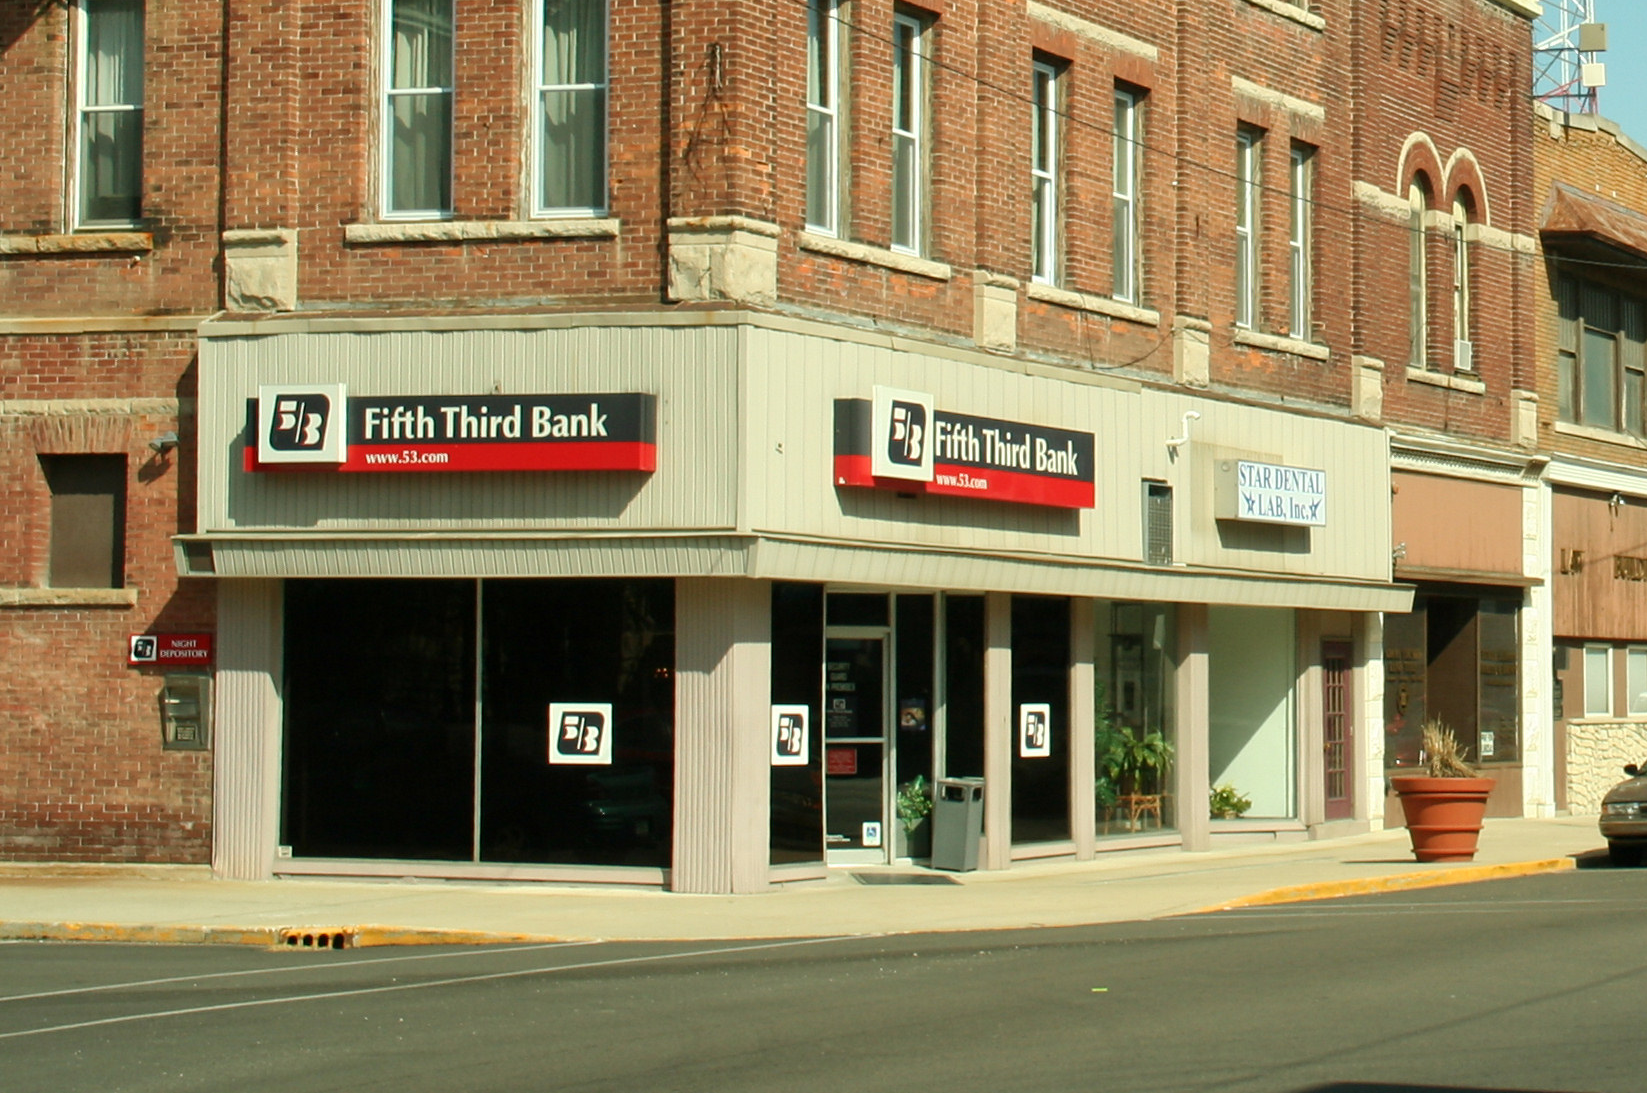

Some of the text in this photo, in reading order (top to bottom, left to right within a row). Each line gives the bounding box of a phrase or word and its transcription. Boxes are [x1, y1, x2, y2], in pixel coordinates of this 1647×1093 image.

[365, 402, 608, 440] Fifth Third Bank
[366, 450, 449, 465] www.53.com
[935, 420, 1078, 476] Fifth Third Bank
[936, 473, 988, 489] www.53.com
[1239, 464, 1323, 495] STAR DENTAL
[1258, 493, 1309, 521] LAB, Inc.
[160, 649, 208, 658] DEPOSITORY
[171, 640, 197, 648] NIGHT
